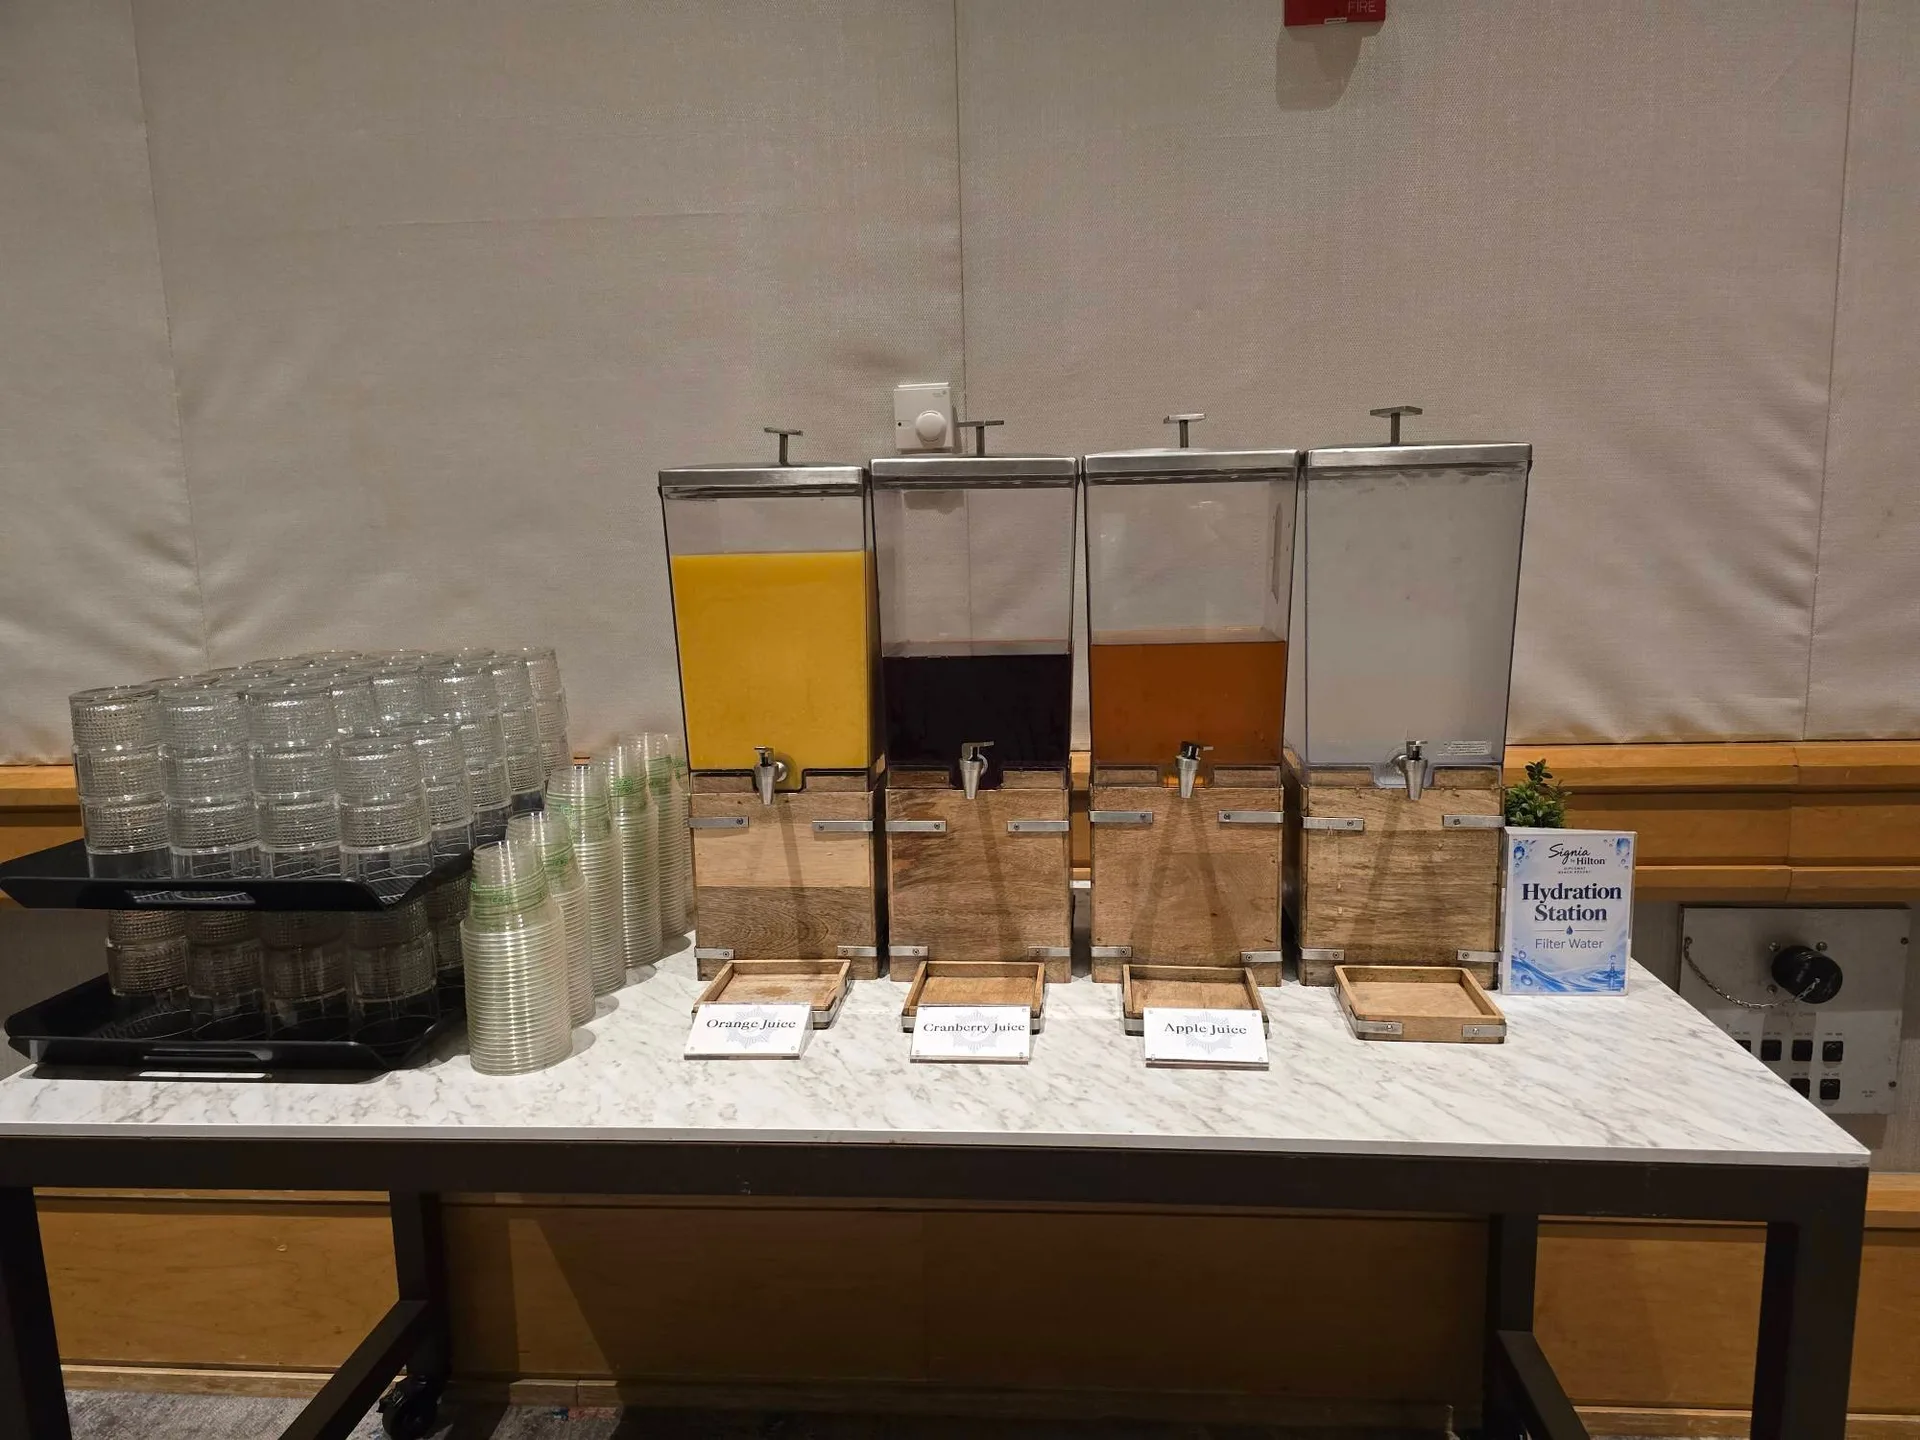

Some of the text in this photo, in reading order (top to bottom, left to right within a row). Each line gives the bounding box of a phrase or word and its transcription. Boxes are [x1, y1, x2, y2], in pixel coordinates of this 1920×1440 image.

[1347, 0, 1377, 13] FIRE
[1548, 843, 1591, 865] Signia
[1576, 857, 1606, 865] Hilton
[1521, 882, 1622, 903] Hydration
[1534, 903, 1607, 922] Station
[1535, 938, 1604, 949] Filter Water
[706, 1019, 796, 1030] Orange Juice
[923, 1023, 1025, 1034] Cranberry Juice
[1165, 1023, 1247, 1036] Apple Juice
